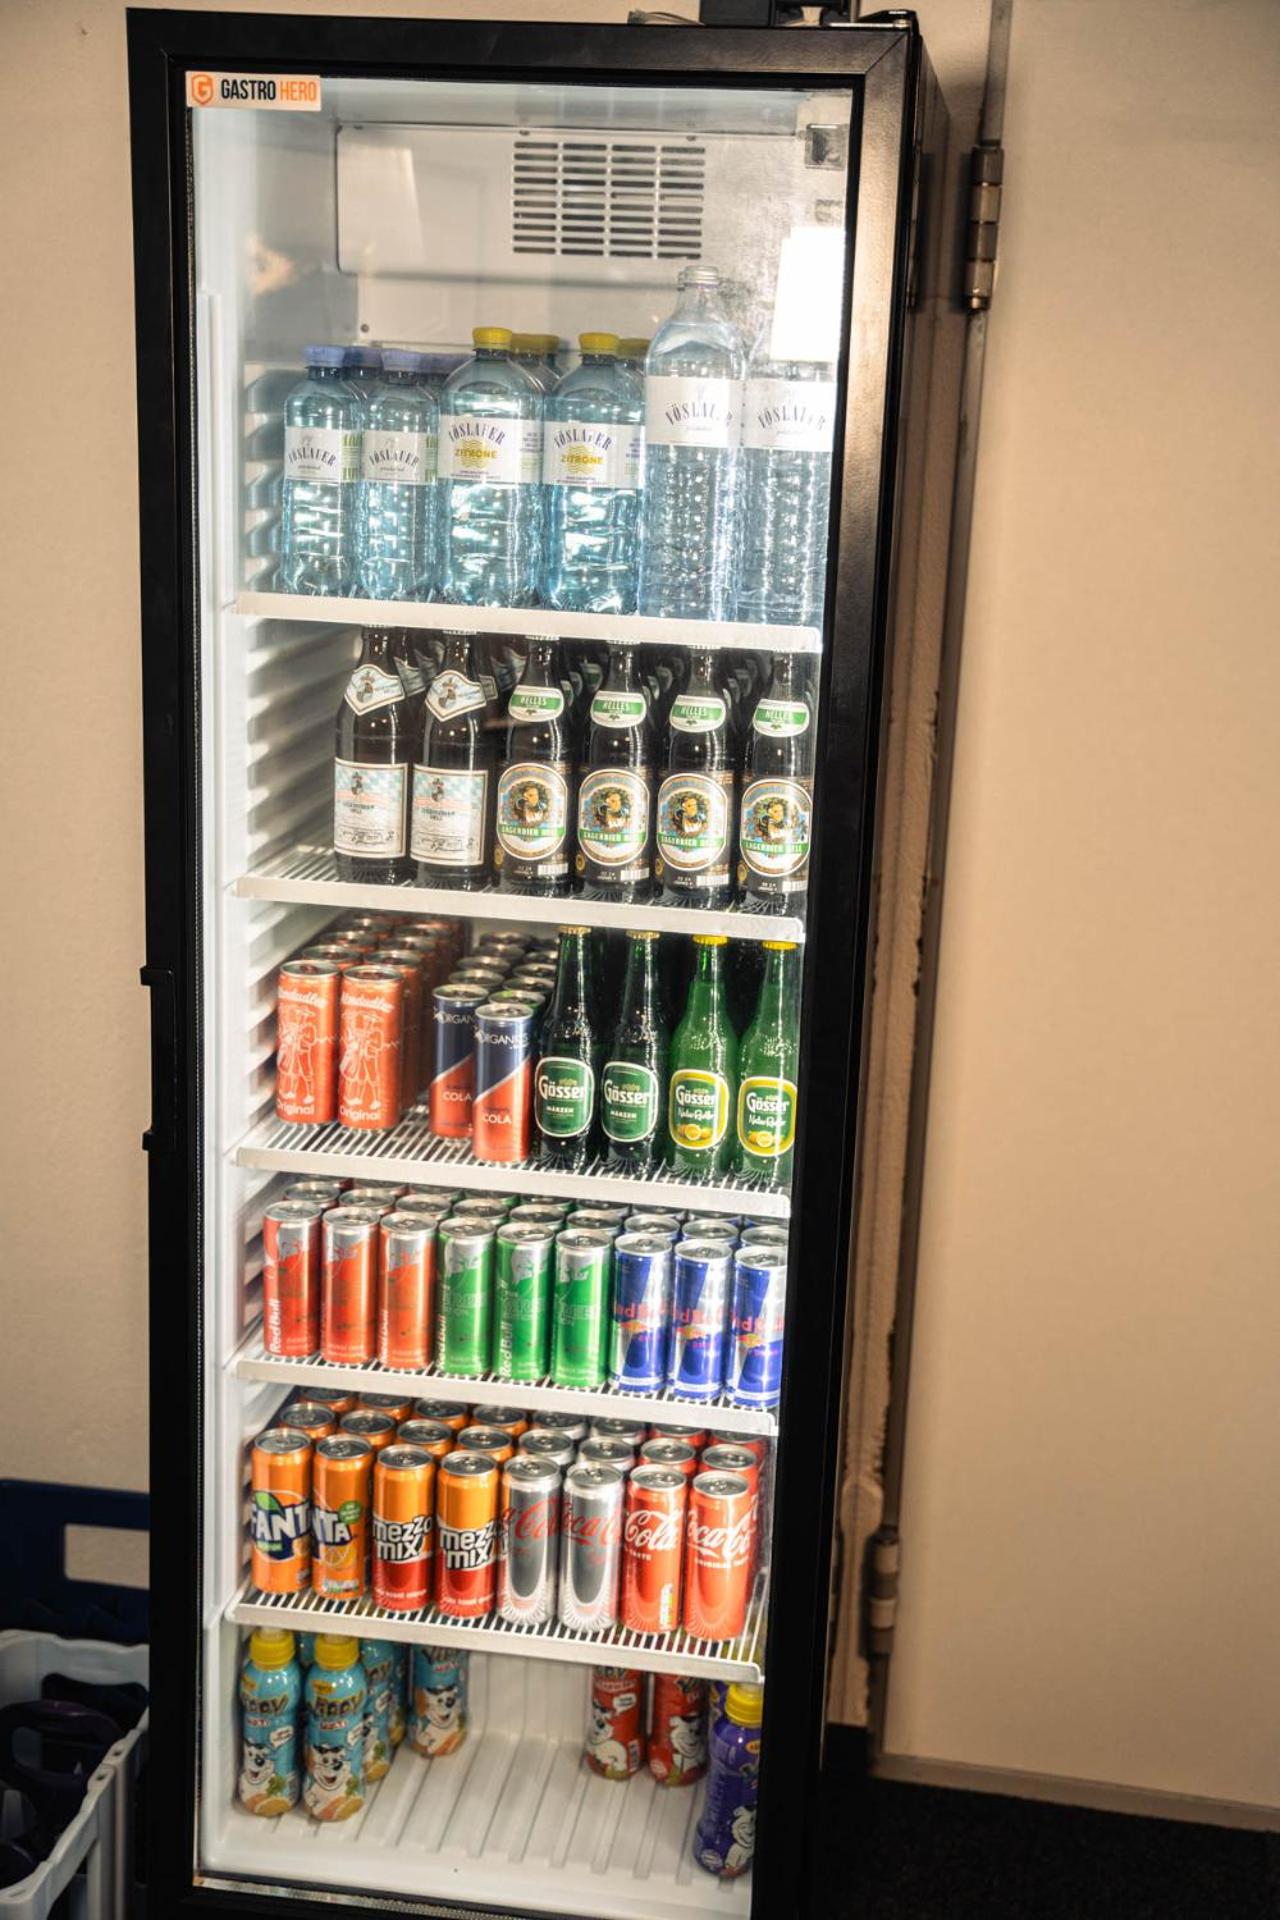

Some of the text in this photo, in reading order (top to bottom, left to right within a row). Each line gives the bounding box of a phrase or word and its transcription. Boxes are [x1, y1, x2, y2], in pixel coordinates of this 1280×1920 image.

[221, 79, 277, 101] GASTRO
[280, 81, 317, 101] HERO
[442, 1091, 472, 1102] COLA
[538, 1075, 587, 1100] Gösser
[603, 1079, 651, 1105] Gösser
[675, 1084, 718, 1107] Gösser
[746, 1092, 790, 1114] Gösser
[482, 1112, 513, 1125] COLA
[373, 1516, 432, 1542] mezzo
[377, 1533, 422, 1561] mix
[445, 1538, 494, 1569] mix
